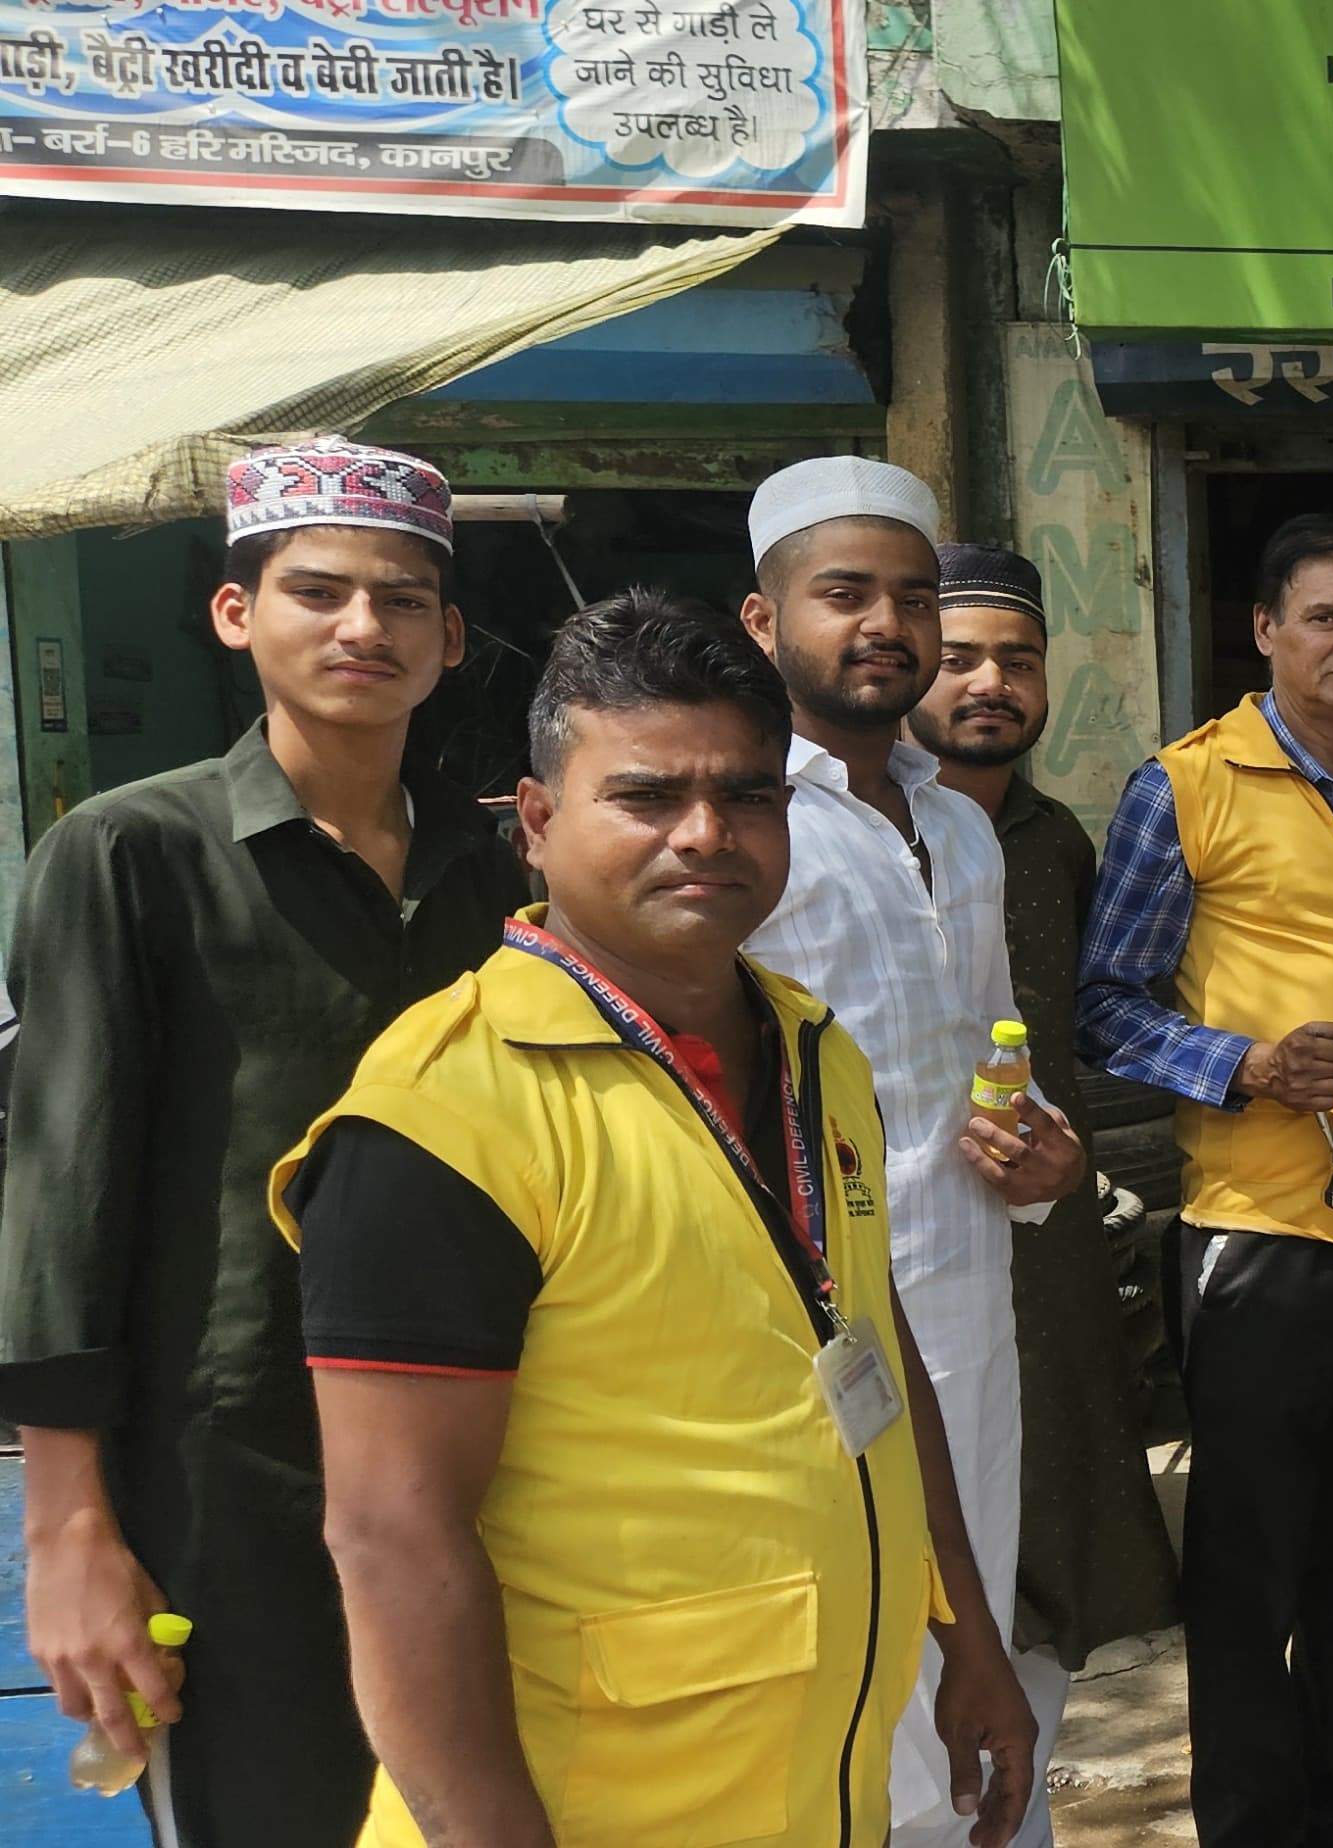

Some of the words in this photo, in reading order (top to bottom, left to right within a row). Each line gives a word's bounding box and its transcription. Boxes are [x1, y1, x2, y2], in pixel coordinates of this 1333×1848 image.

[582, 8, 626, 36] घर
[636, 2, 662, 37] से
[673, 2, 740, 45] गाड़ी
[749, 4, 780, 41] ले
[162, 39, 271, 91] खरीदी
[277, 52, 306, 92] व
[312, 42, 379, 95] बेची
[386, 48, 472, 100] जाती
[574, 51, 638, 88] जाने
[646, 51, 688, 89] की
[697, 56, 793, 102] सुविधा
[613, 110, 720, 142] उपलब्ध
[159, 129, 224, 163] हरि
[379, 142, 514, 179] कानपुर
[560, 953, 640, 1025] DEFENCE
[637, 1020, 676, 1066] CIVIL
[793, 1155, 815, 1197] CIVIL
